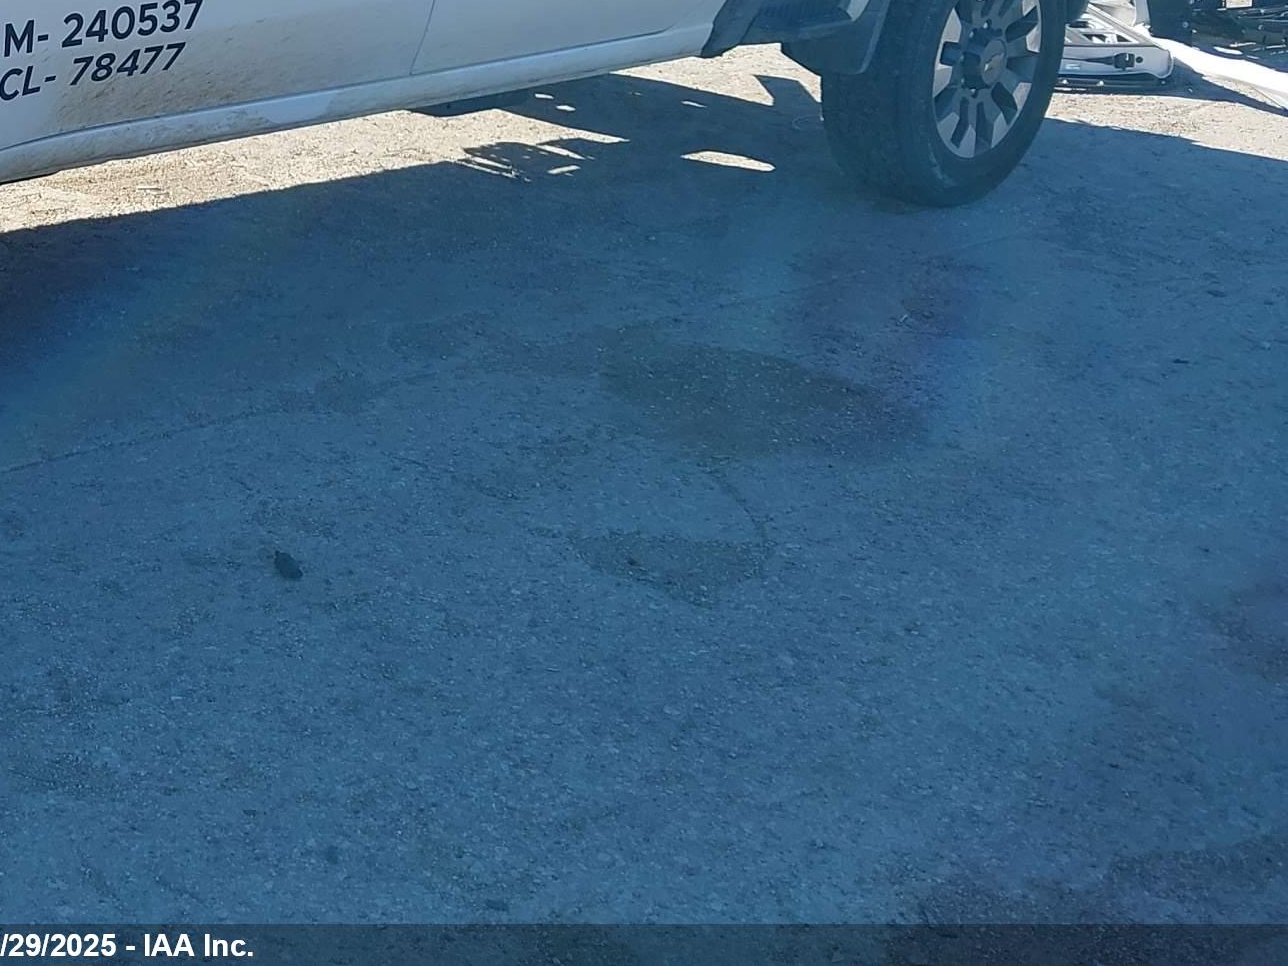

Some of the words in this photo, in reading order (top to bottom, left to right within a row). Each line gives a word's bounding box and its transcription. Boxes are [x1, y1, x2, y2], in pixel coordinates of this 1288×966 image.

[3, 20, 49, 57] M-
[0, 65, 57, 101] CL-
[69, 42, 186, 86] 78477
